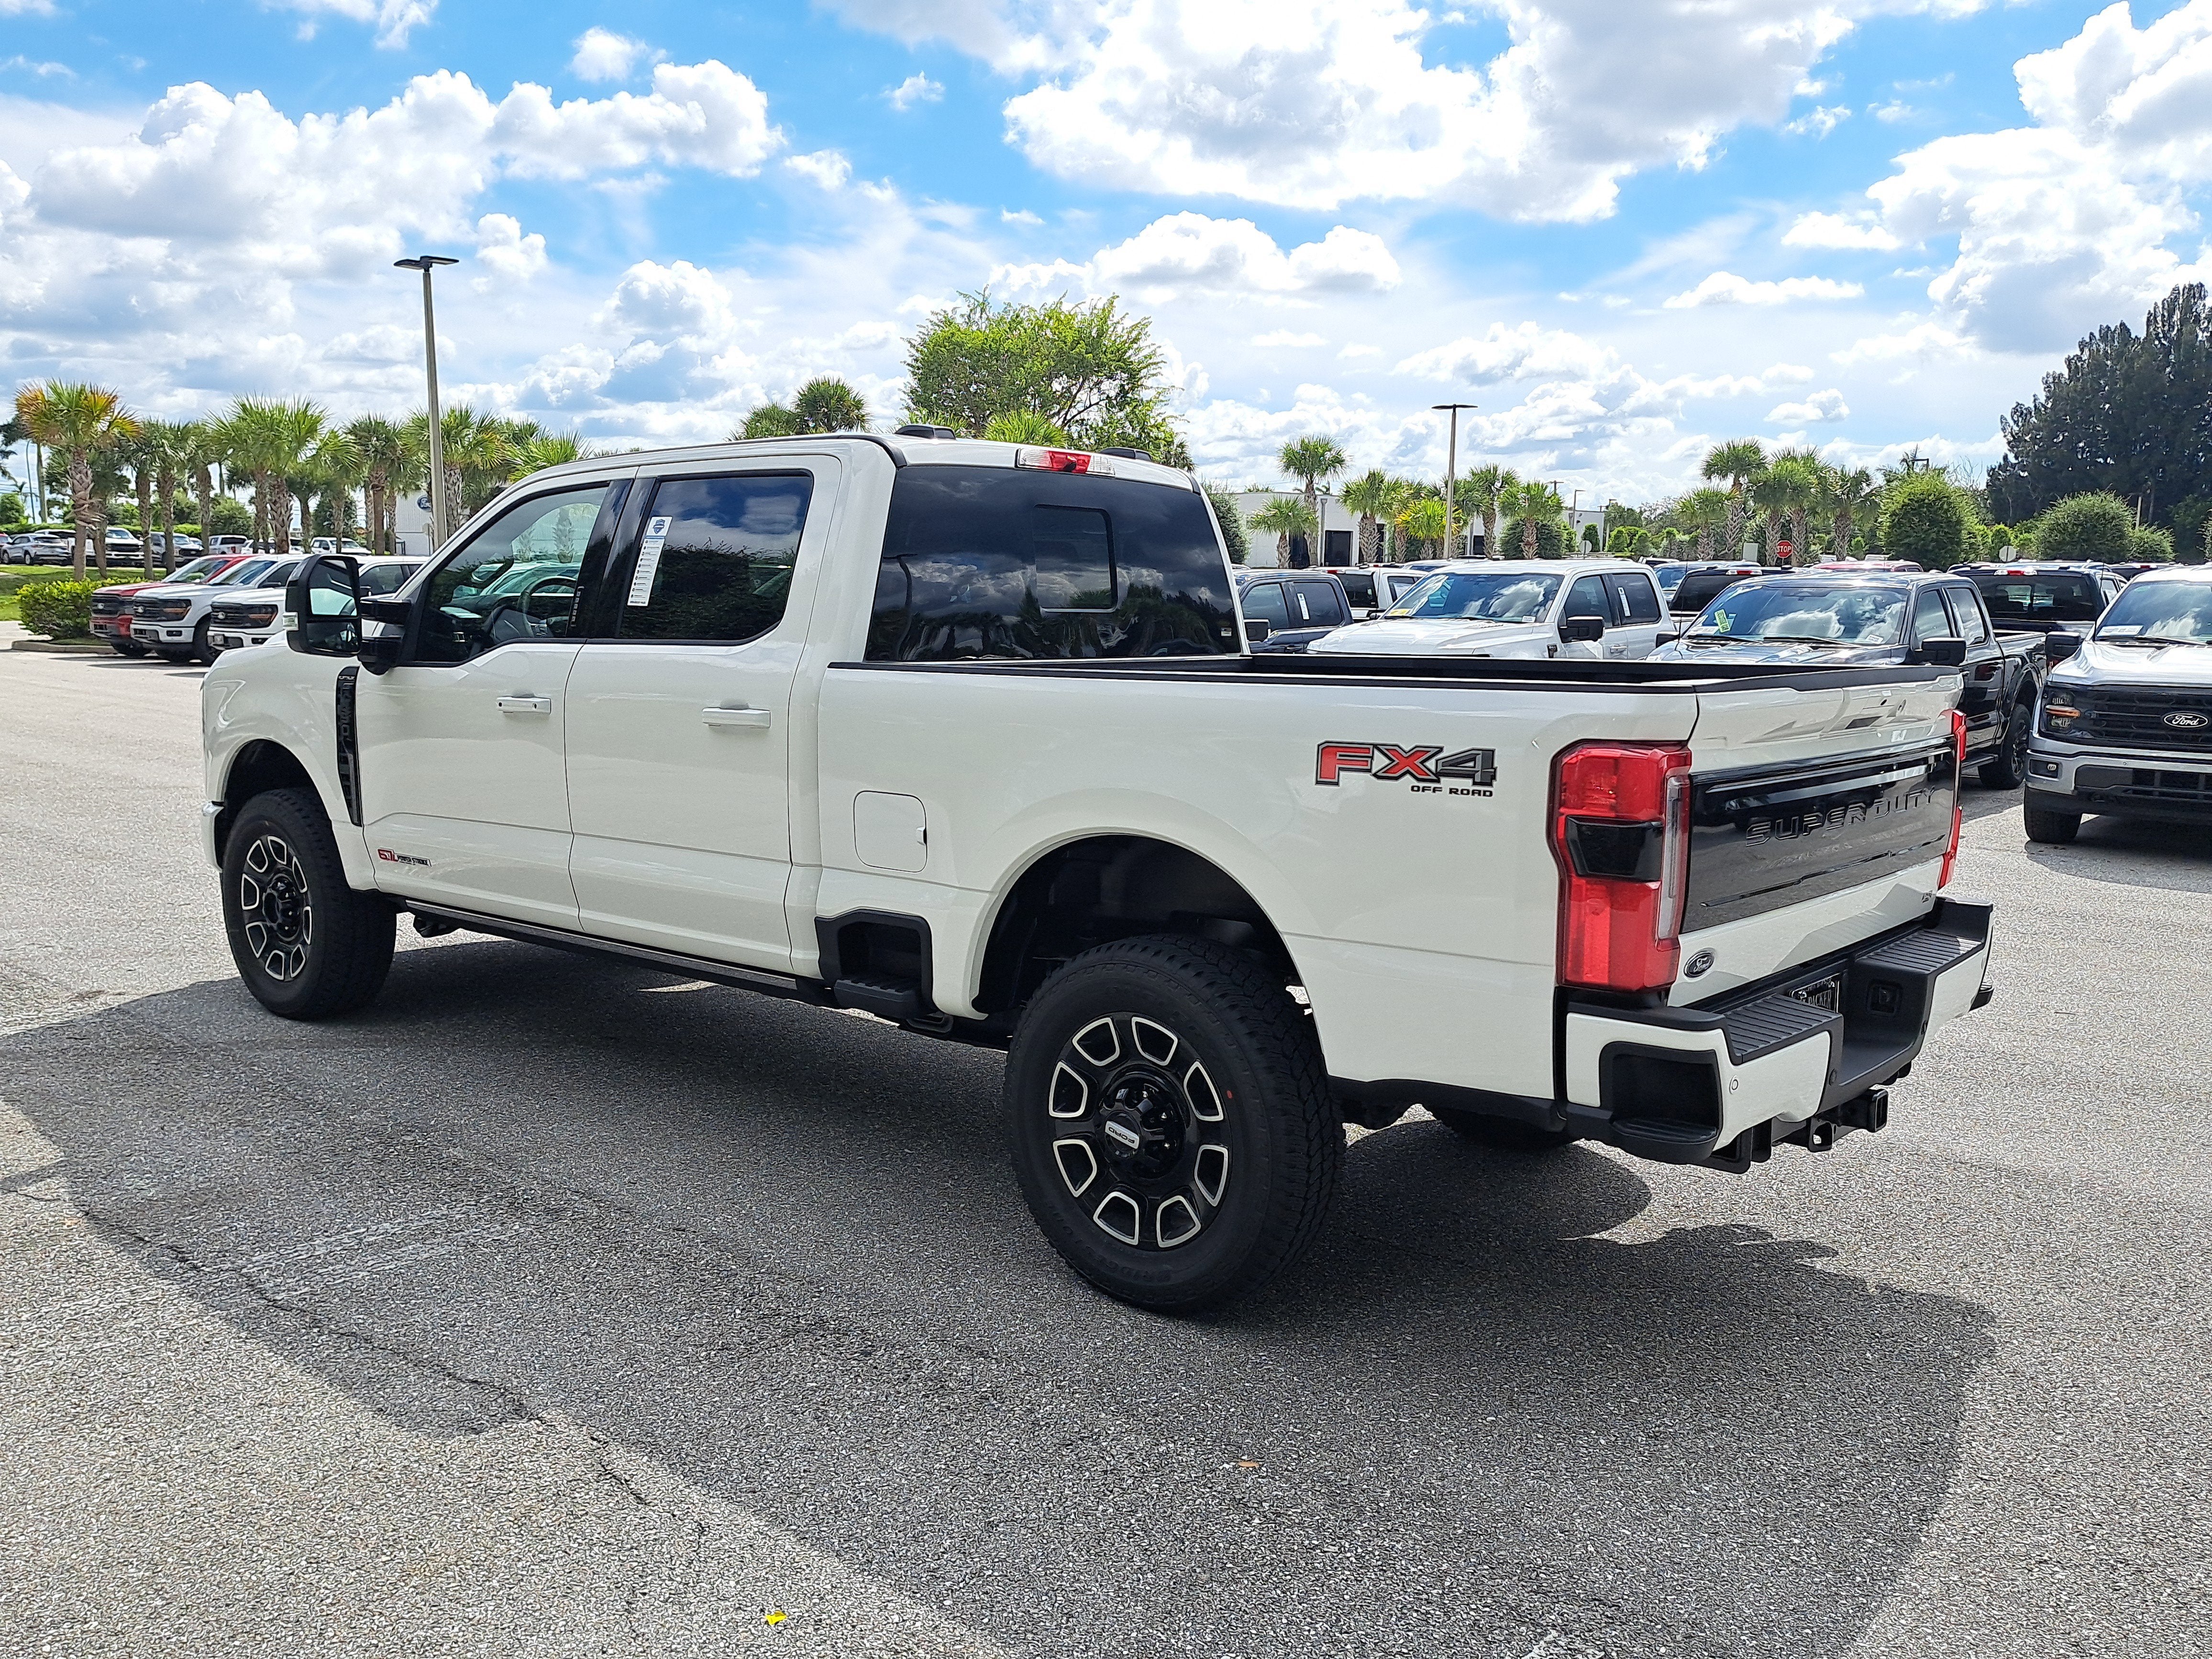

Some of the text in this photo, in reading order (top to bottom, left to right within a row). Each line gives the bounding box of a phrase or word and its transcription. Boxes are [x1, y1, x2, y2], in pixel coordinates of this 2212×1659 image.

[2172, 715, 2200, 725] Ford
[1315, 741, 1498, 787] FX4
[1411, 785, 1493, 797] OFF ROAD
[1746, 785, 1936, 847] SUPER DUTY
[1693, 957, 1712, 973] Ford
[1108, 1127, 1135, 1144] FORD
